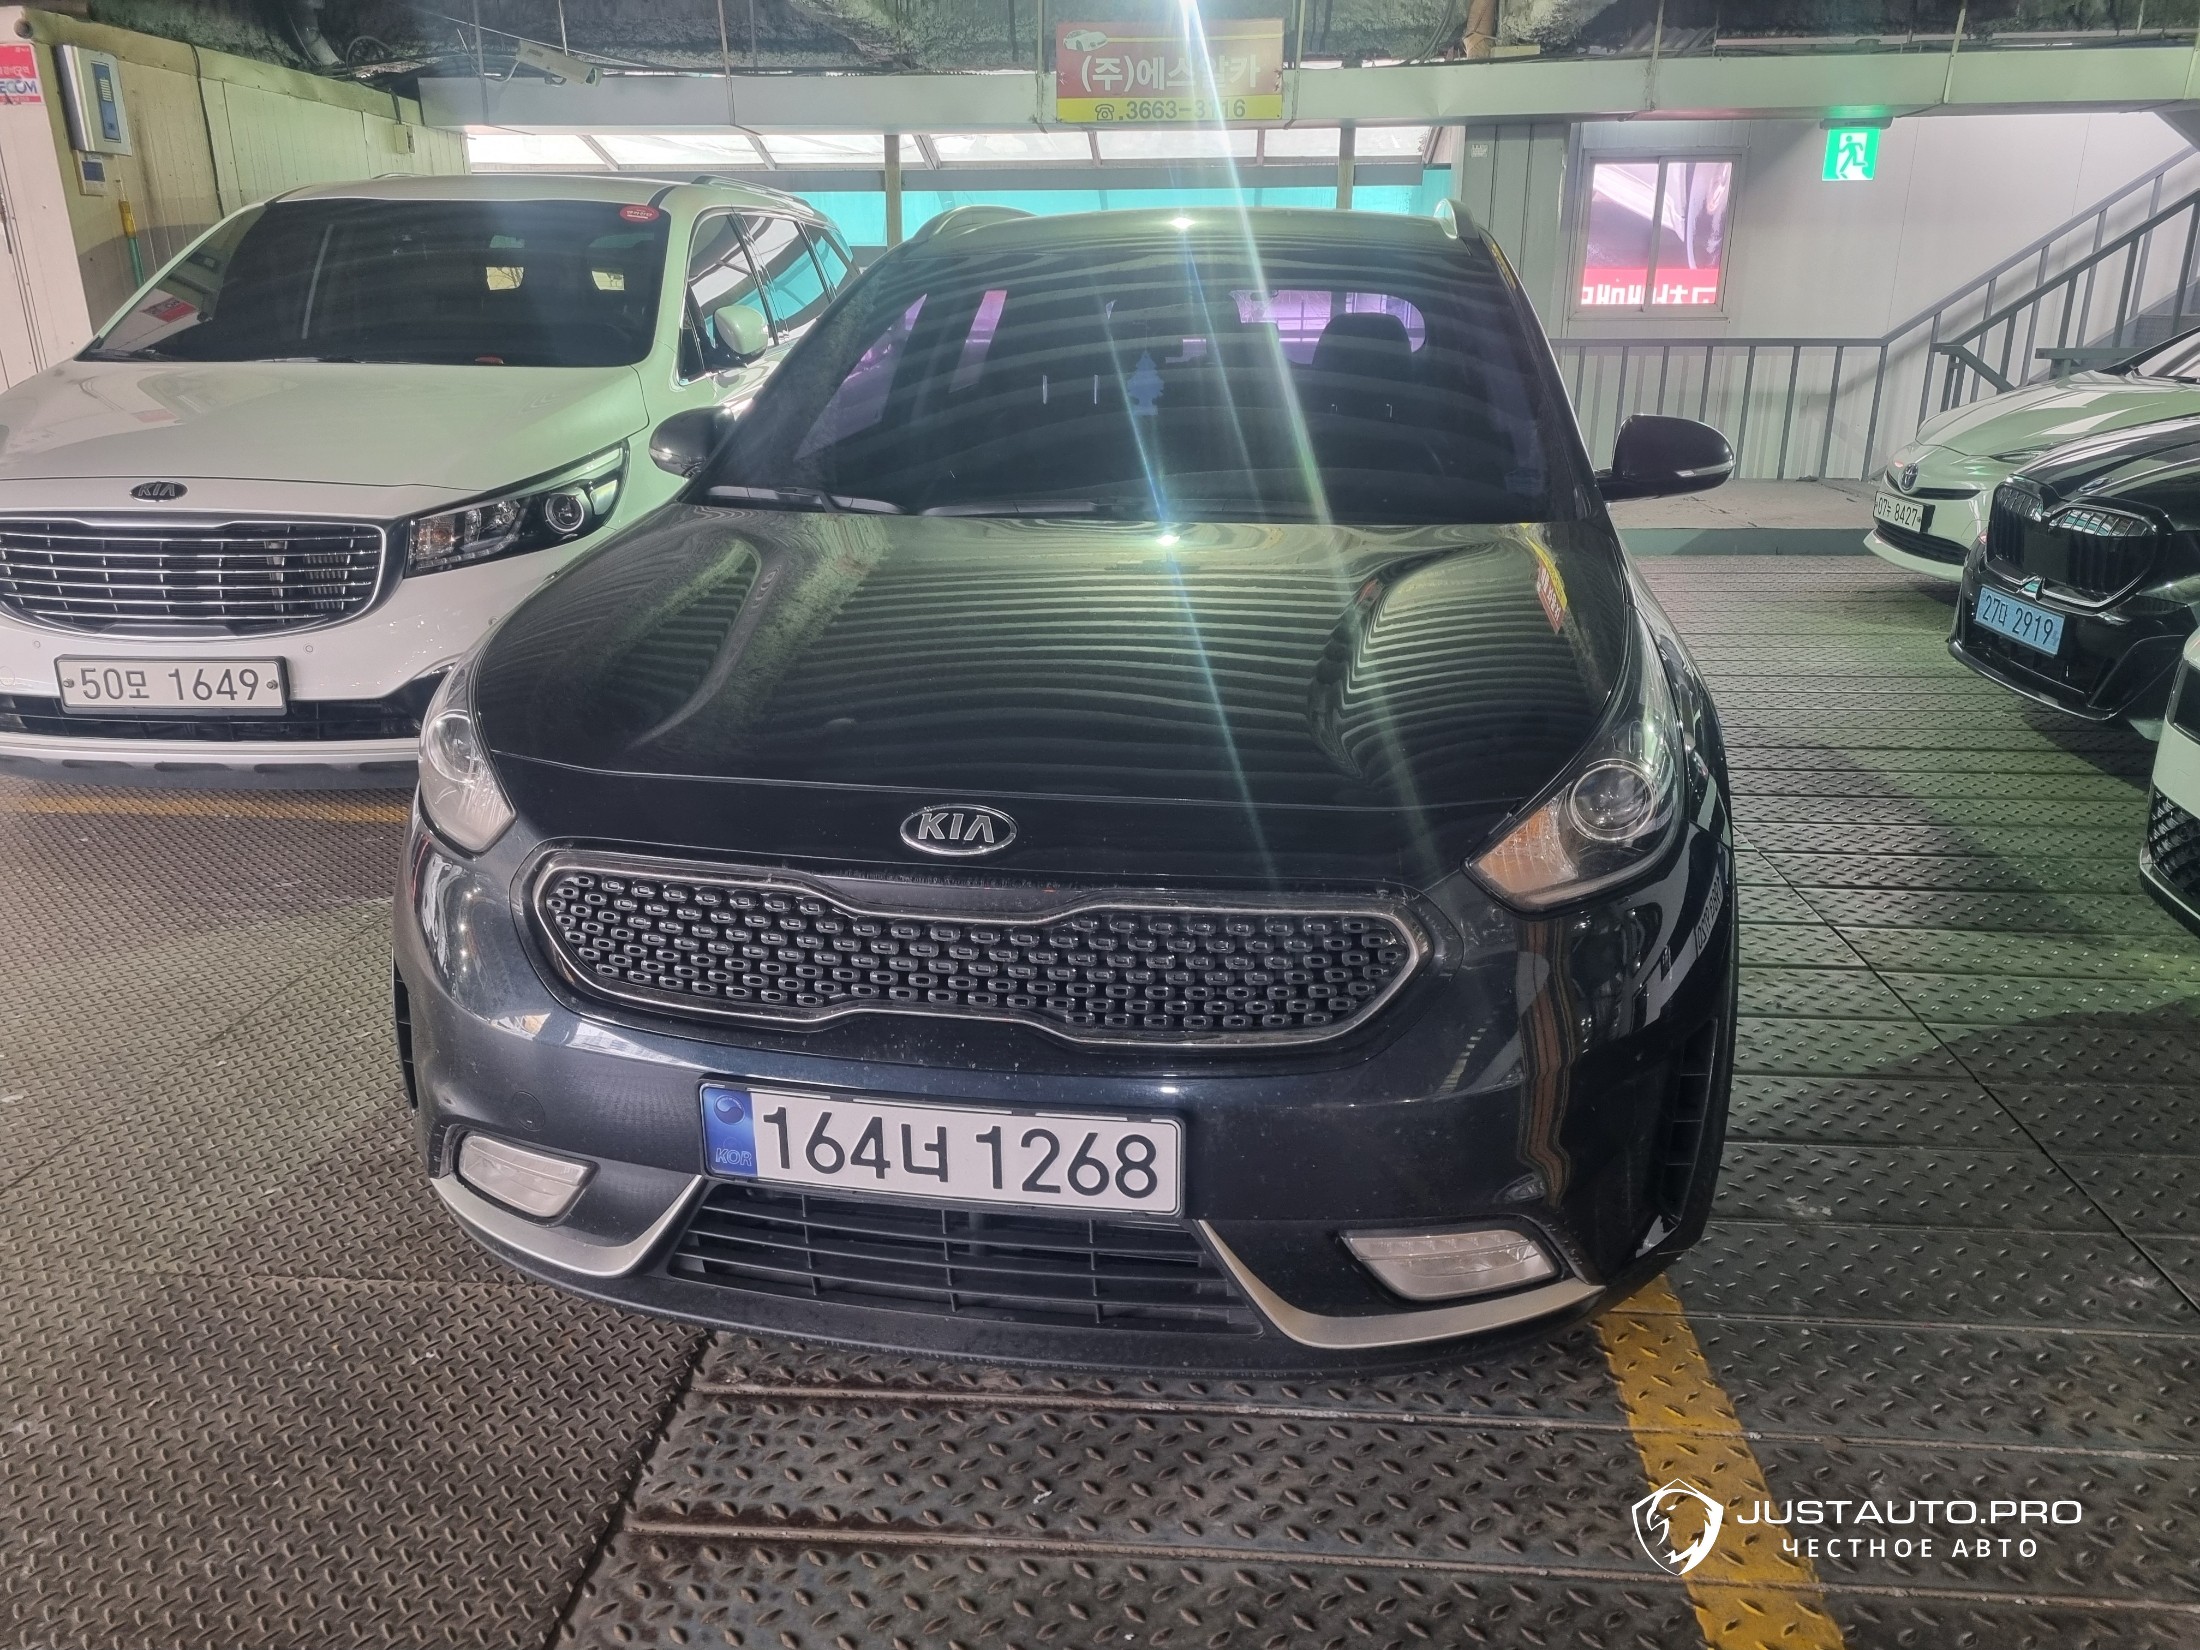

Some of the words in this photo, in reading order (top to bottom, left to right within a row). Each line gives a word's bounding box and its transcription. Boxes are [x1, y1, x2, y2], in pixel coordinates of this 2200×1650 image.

[138, 483, 176, 497] KIA
[1894, 503, 1918, 527] 8427
[1982, 594, 2009, 627] 27다
[2012, 607, 2054, 645] 2919
[80, 667, 150, 700] 50모
[168, 668, 259, 701] 1649
[917, 812, 995, 843] KIA
[715, 1147, 752, 1166] KOR
[763, 1106, 949, 1183] 164너
[975, 1125, 1158, 1199] 1268
